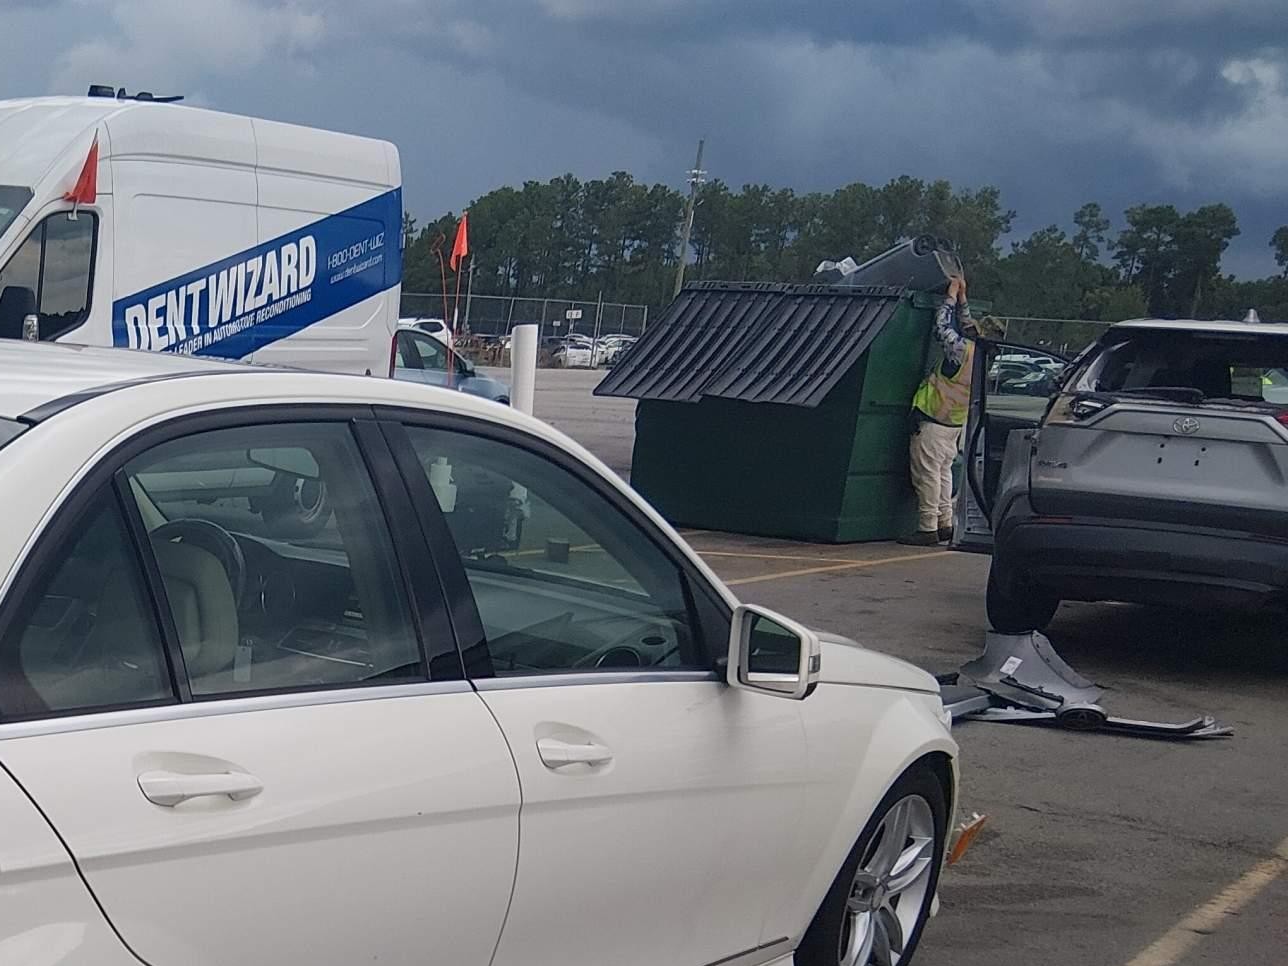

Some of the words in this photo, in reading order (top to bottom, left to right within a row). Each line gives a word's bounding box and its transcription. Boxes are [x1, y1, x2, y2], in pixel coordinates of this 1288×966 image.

[327, 231, 385, 270] 1-800-DENT-WIZ
[125, 278, 207, 351] DENT
[208, 235, 317, 328] WIZARD
[204, 331, 212, 347] IN
[213, 312, 255, 342] AUTOMOTIVE
[256, 287, 312, 324] RECONDITIONING
